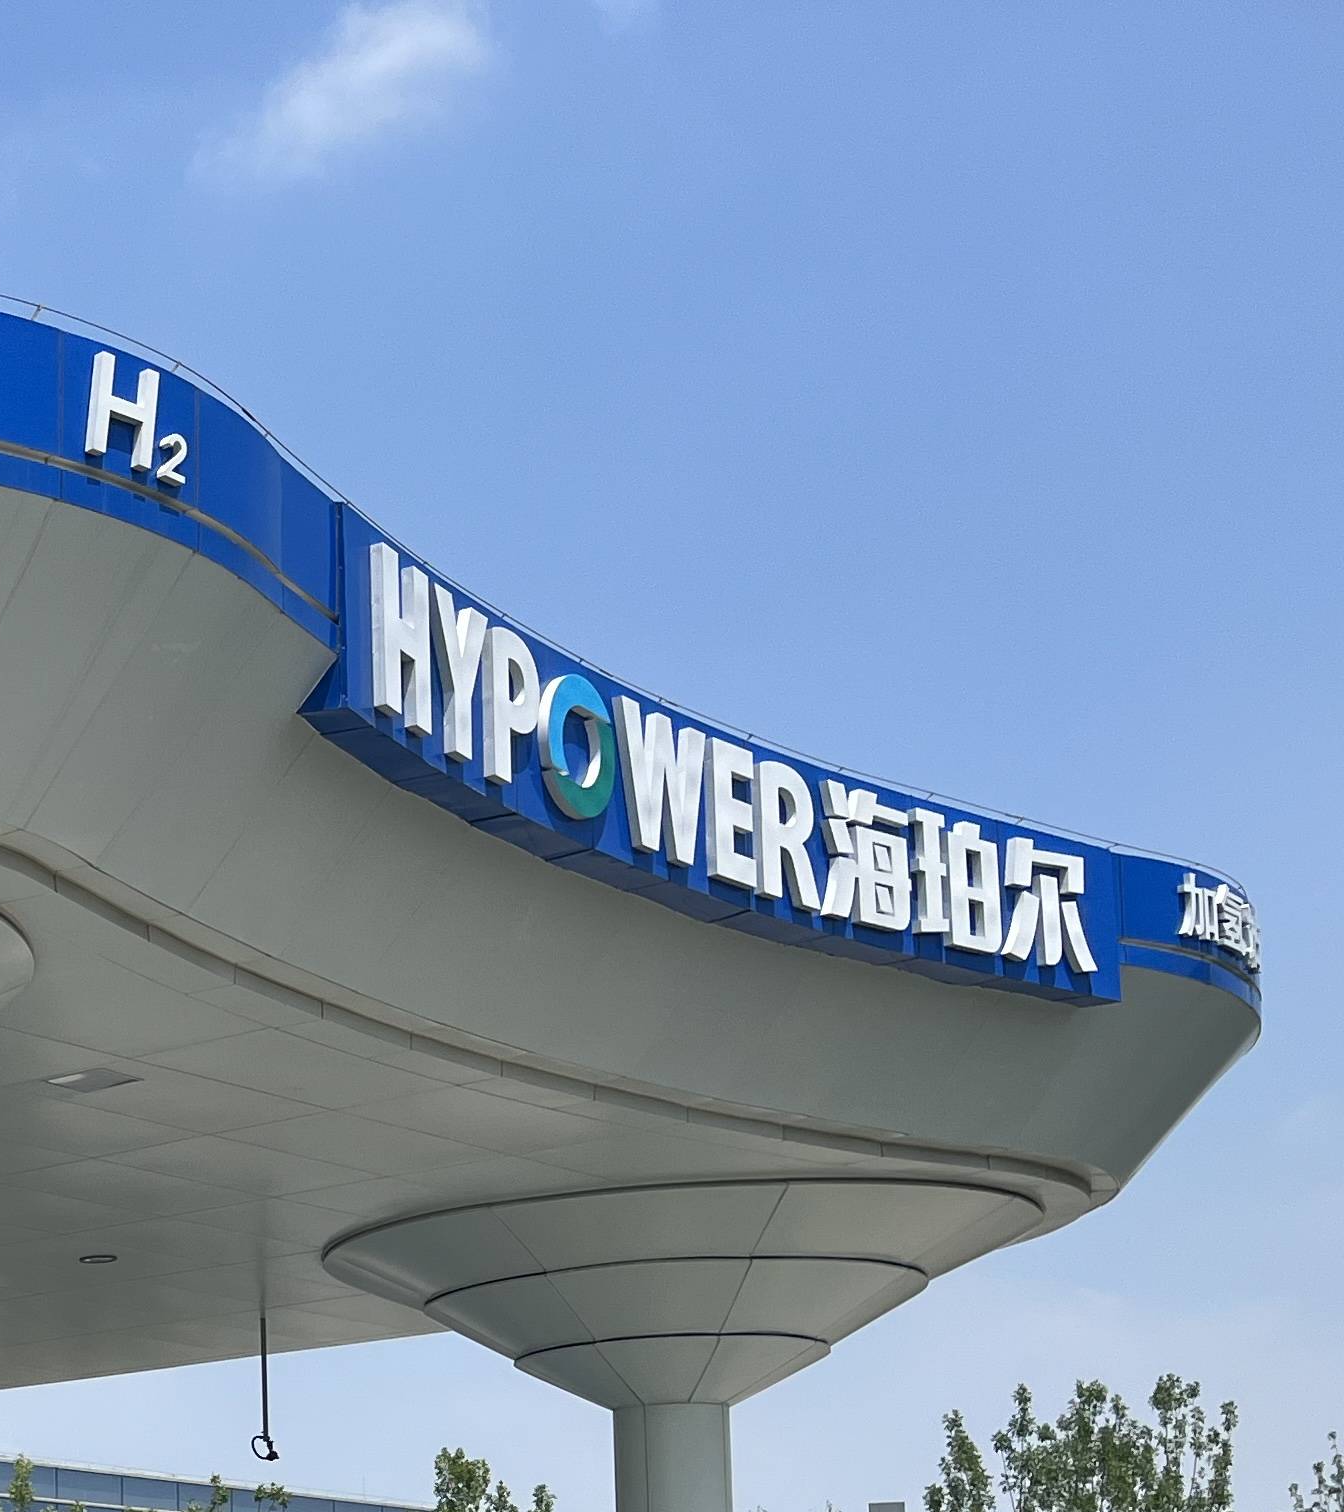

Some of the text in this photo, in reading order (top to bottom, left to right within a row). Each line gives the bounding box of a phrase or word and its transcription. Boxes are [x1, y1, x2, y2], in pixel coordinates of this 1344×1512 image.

[370, 541, 820, 916] HYPOWER
[819, 778, 1099, 973] 海珀尔
